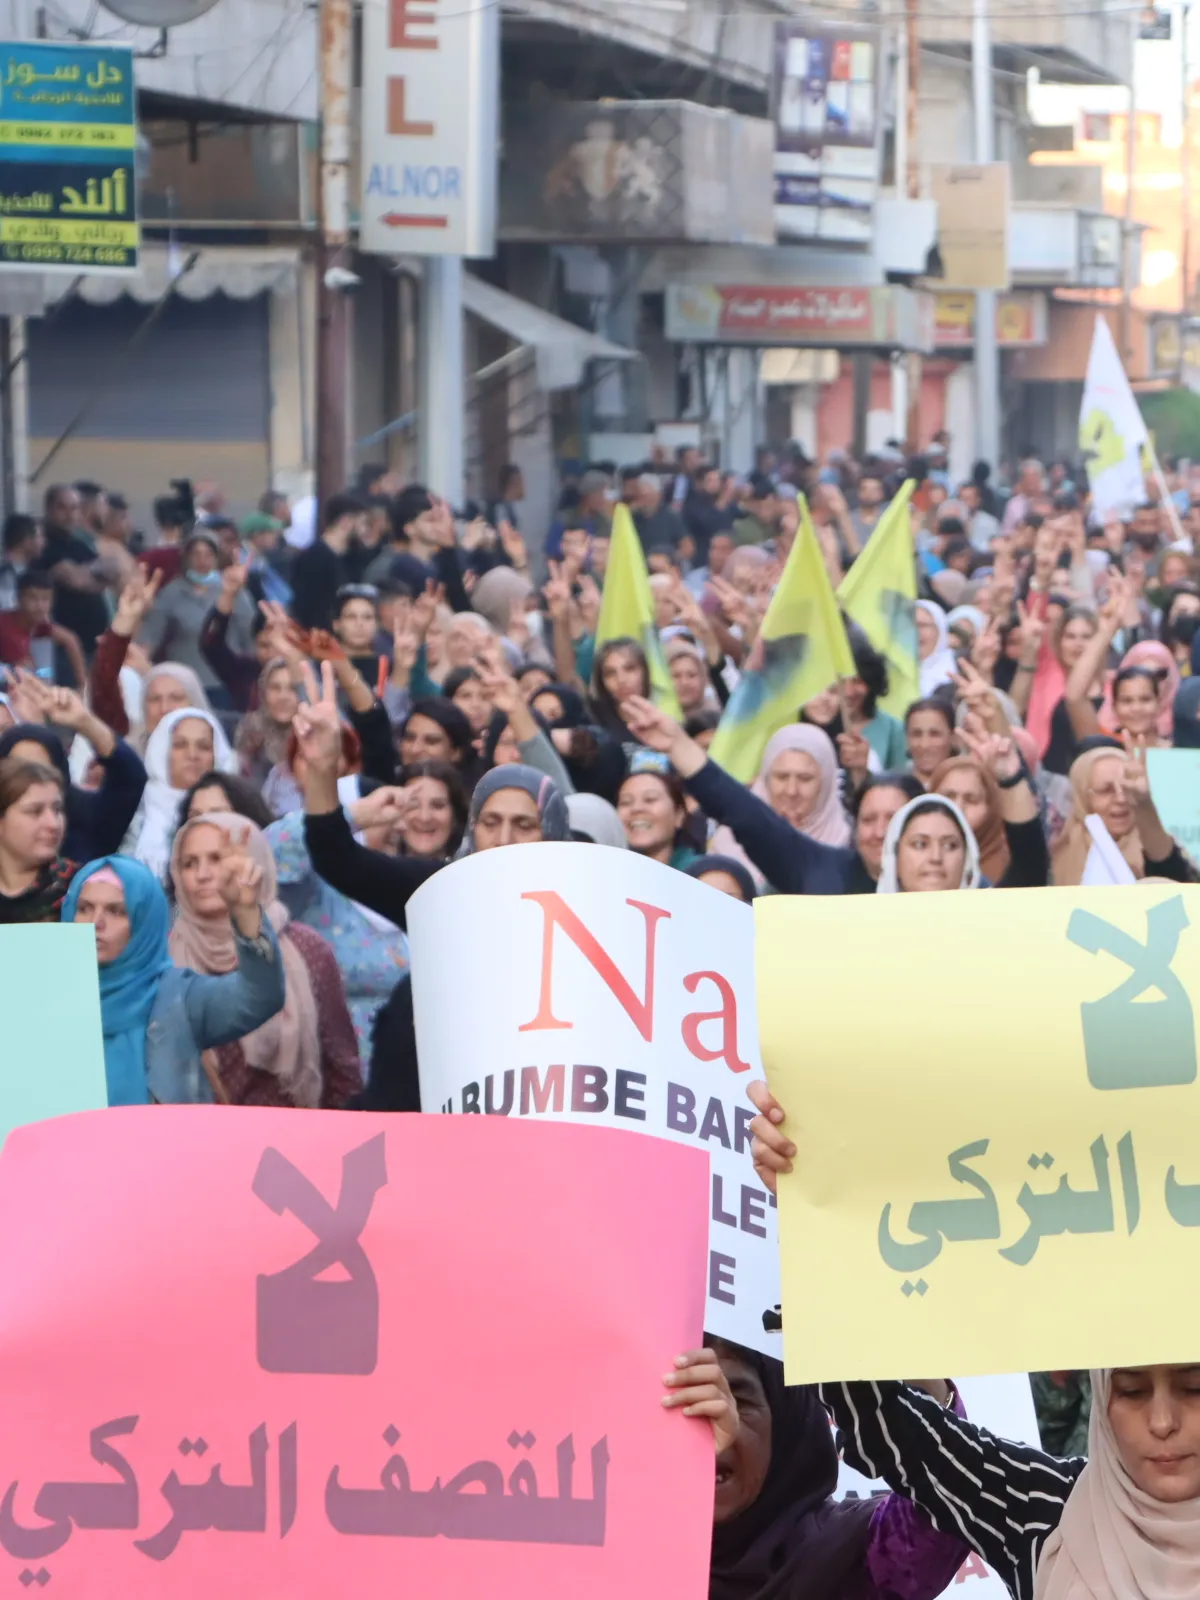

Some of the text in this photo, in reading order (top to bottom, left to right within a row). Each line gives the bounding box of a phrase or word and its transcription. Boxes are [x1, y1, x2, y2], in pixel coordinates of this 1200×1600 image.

[60, 167, 127, 214] ألند
[367, 164, 461, 198] ALNOR
[518, 890, 751, 1074] Na
[1065, 894, 1198, 1091] لا
[462, 1064, 647, 1121] BUMBE
[251, 1131, 388, 1376] لا
[878, 1131, 1140, 1297] التركي
[0, 1414, 611, 1587] للقصف التركي
